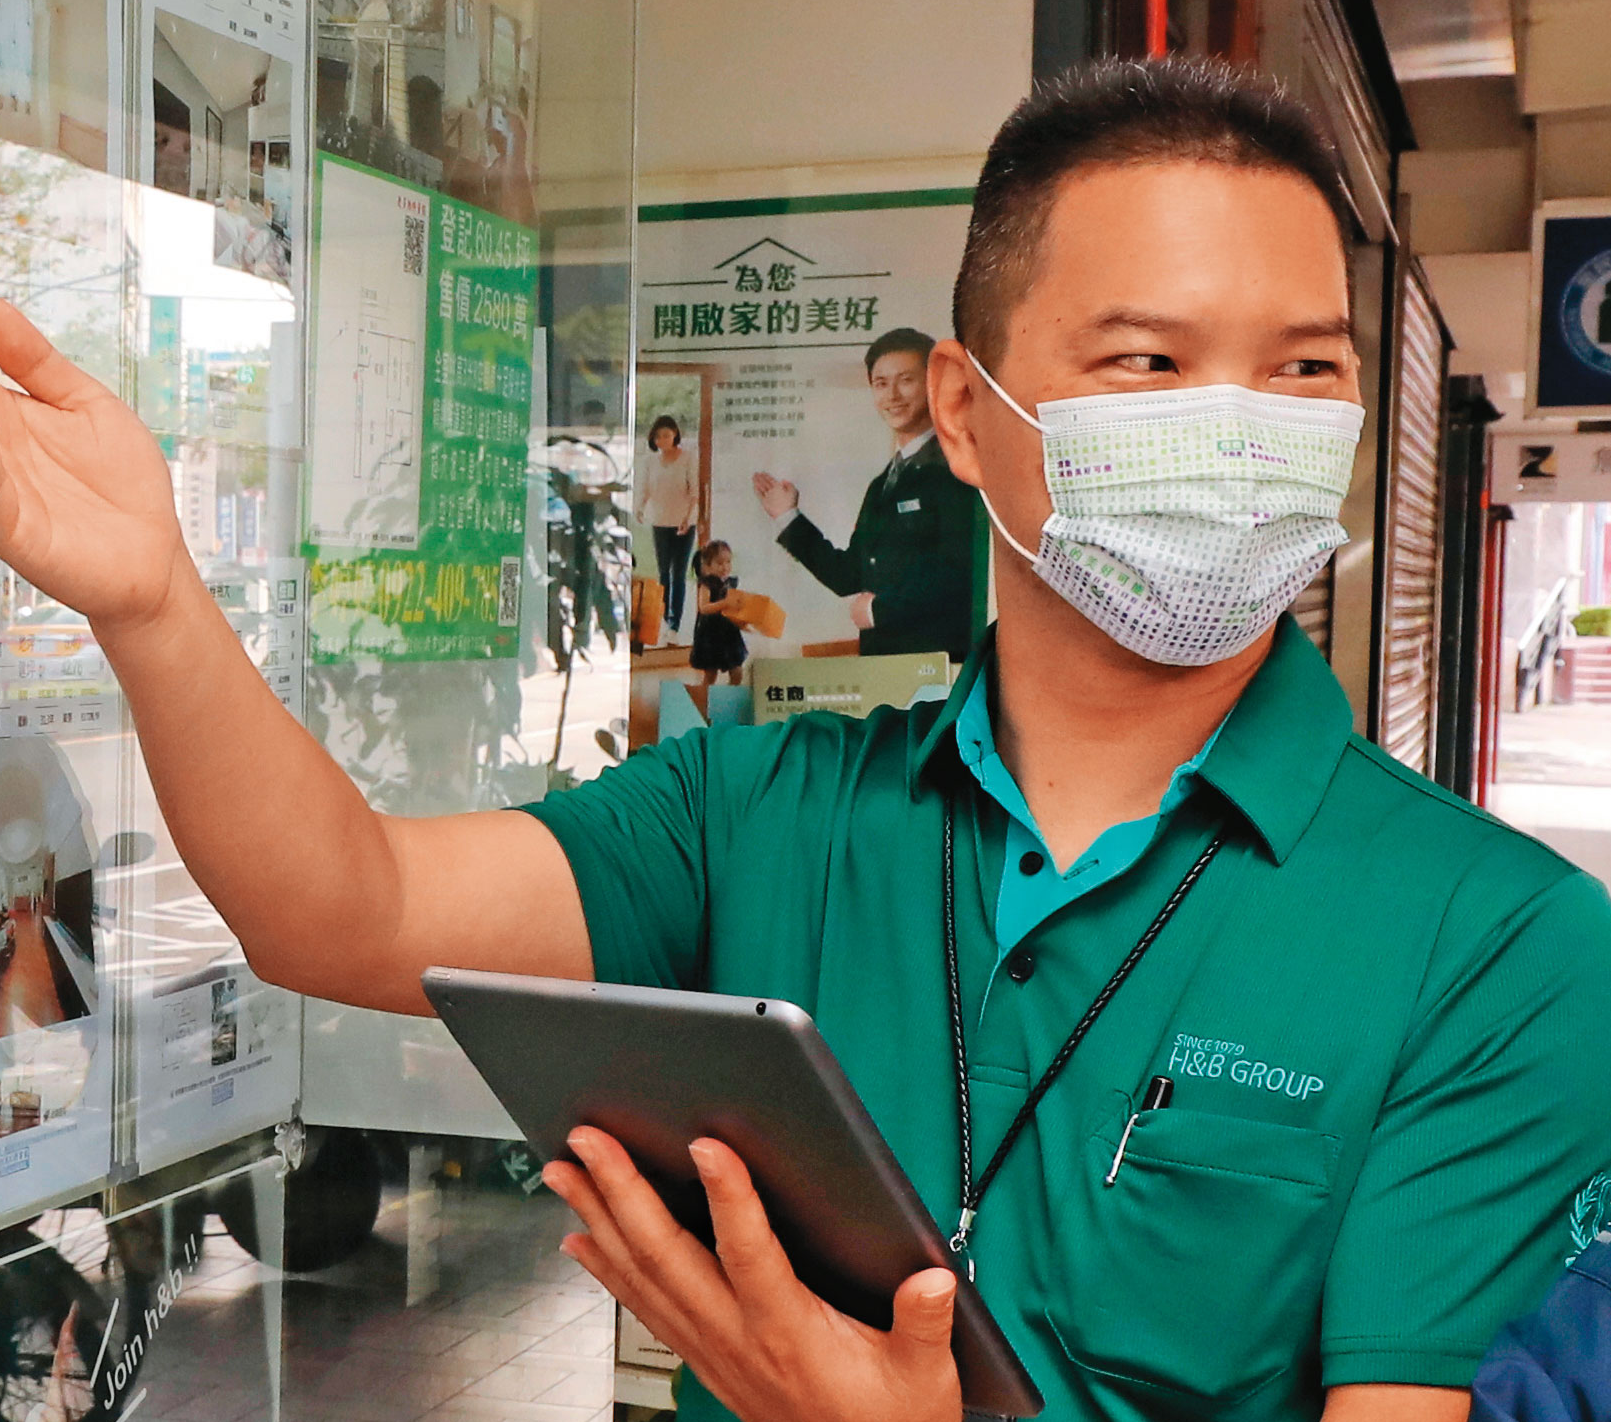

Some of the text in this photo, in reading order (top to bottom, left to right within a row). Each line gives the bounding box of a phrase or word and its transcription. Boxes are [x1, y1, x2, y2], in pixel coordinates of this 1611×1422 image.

[735, 262, 796, 292] 為您
[653, 296, 879, 339] 開啟家的美好
[766, 685, 804, 701] 住商
[1175, 1034, 1245, 1055] SINCE 1979
[1169, 1046, 1325, 1101] H&B GROUP
[103, 1333, 144, 1410] Join
